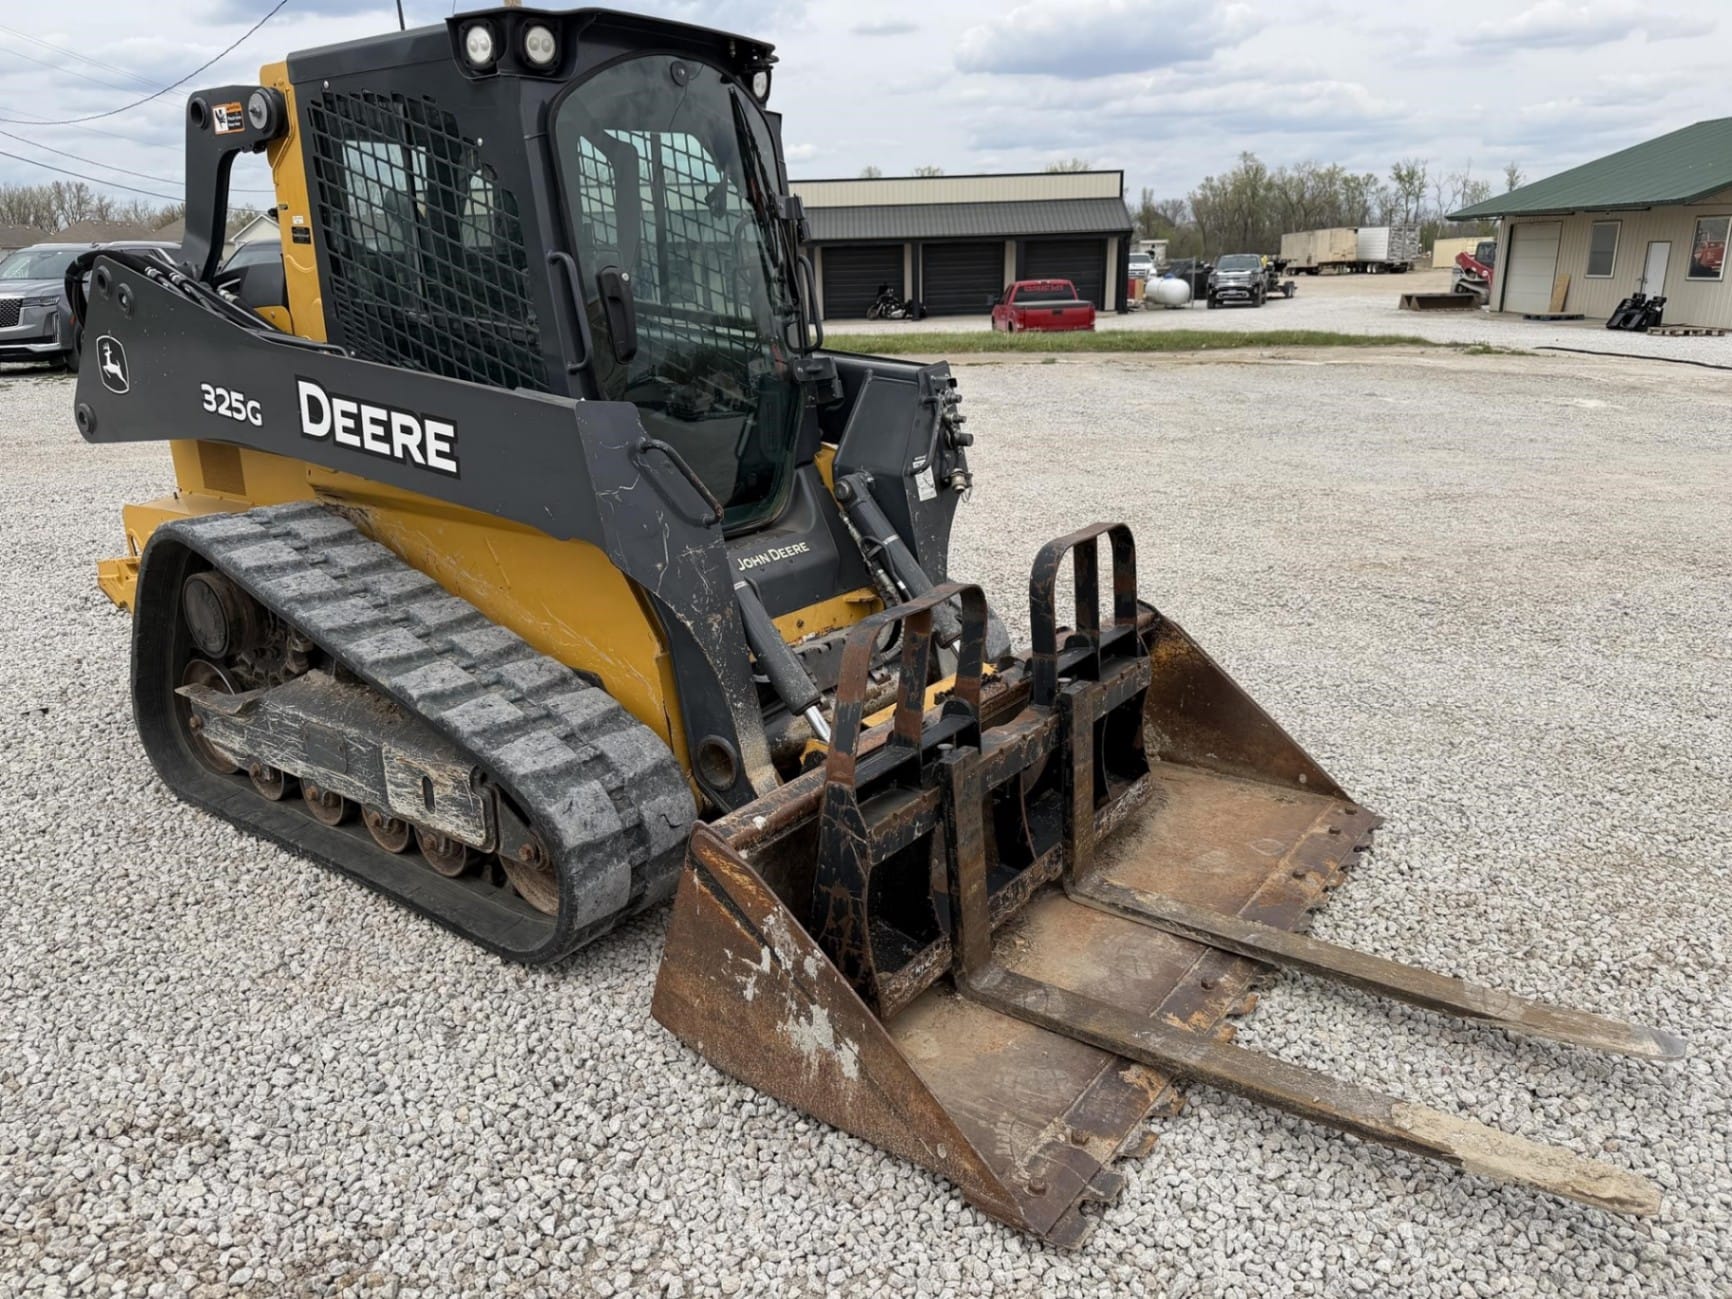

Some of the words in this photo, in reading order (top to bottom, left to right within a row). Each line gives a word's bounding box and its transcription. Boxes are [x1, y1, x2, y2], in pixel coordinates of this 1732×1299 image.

[201, 383, 263, 426] 325G
[297, 380, 457, 473] DEERE
[737, 553, 771, 571] JOHN
[768, 542, 811, 561] DEERE
